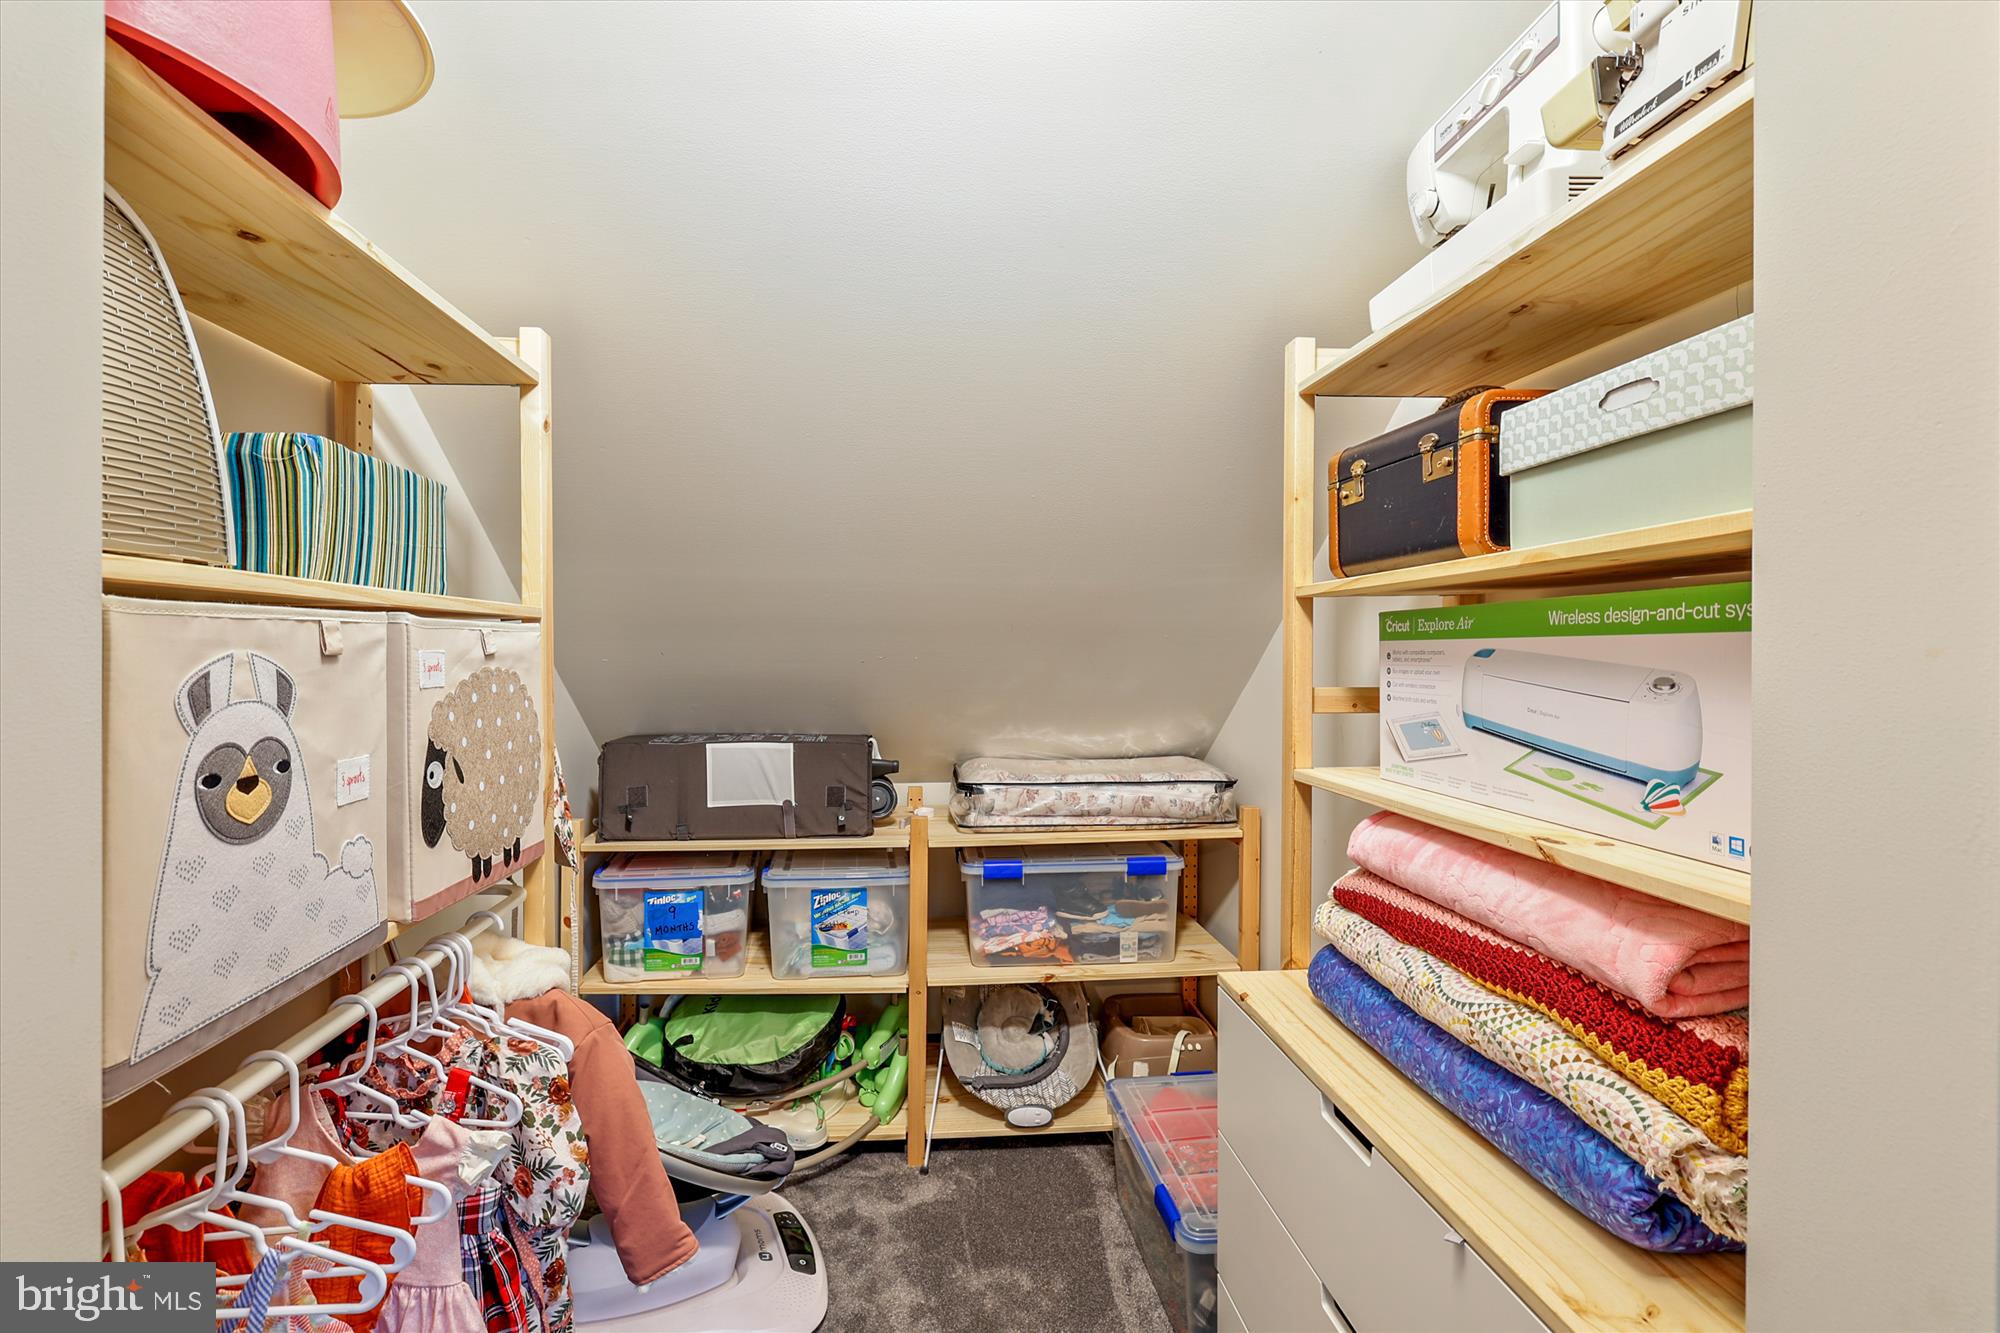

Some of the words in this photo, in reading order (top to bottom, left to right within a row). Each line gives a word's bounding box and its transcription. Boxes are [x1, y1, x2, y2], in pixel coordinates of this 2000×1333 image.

[1548, 608, 1601, 626] Wireless
[1603, 602, 1721, 626] design-and-cut
[1385, 617, 1410, 633] Cricut
[1417, 617, 1455, 634] Explore
[1456, 616, 1475, 630] Air
[813, 891, 841, 910] Ziploc
[667, 905, 677, 920] 9
[655, 921, 695, 936] MONTHS
[702, 995, 721, 1015] Kid
